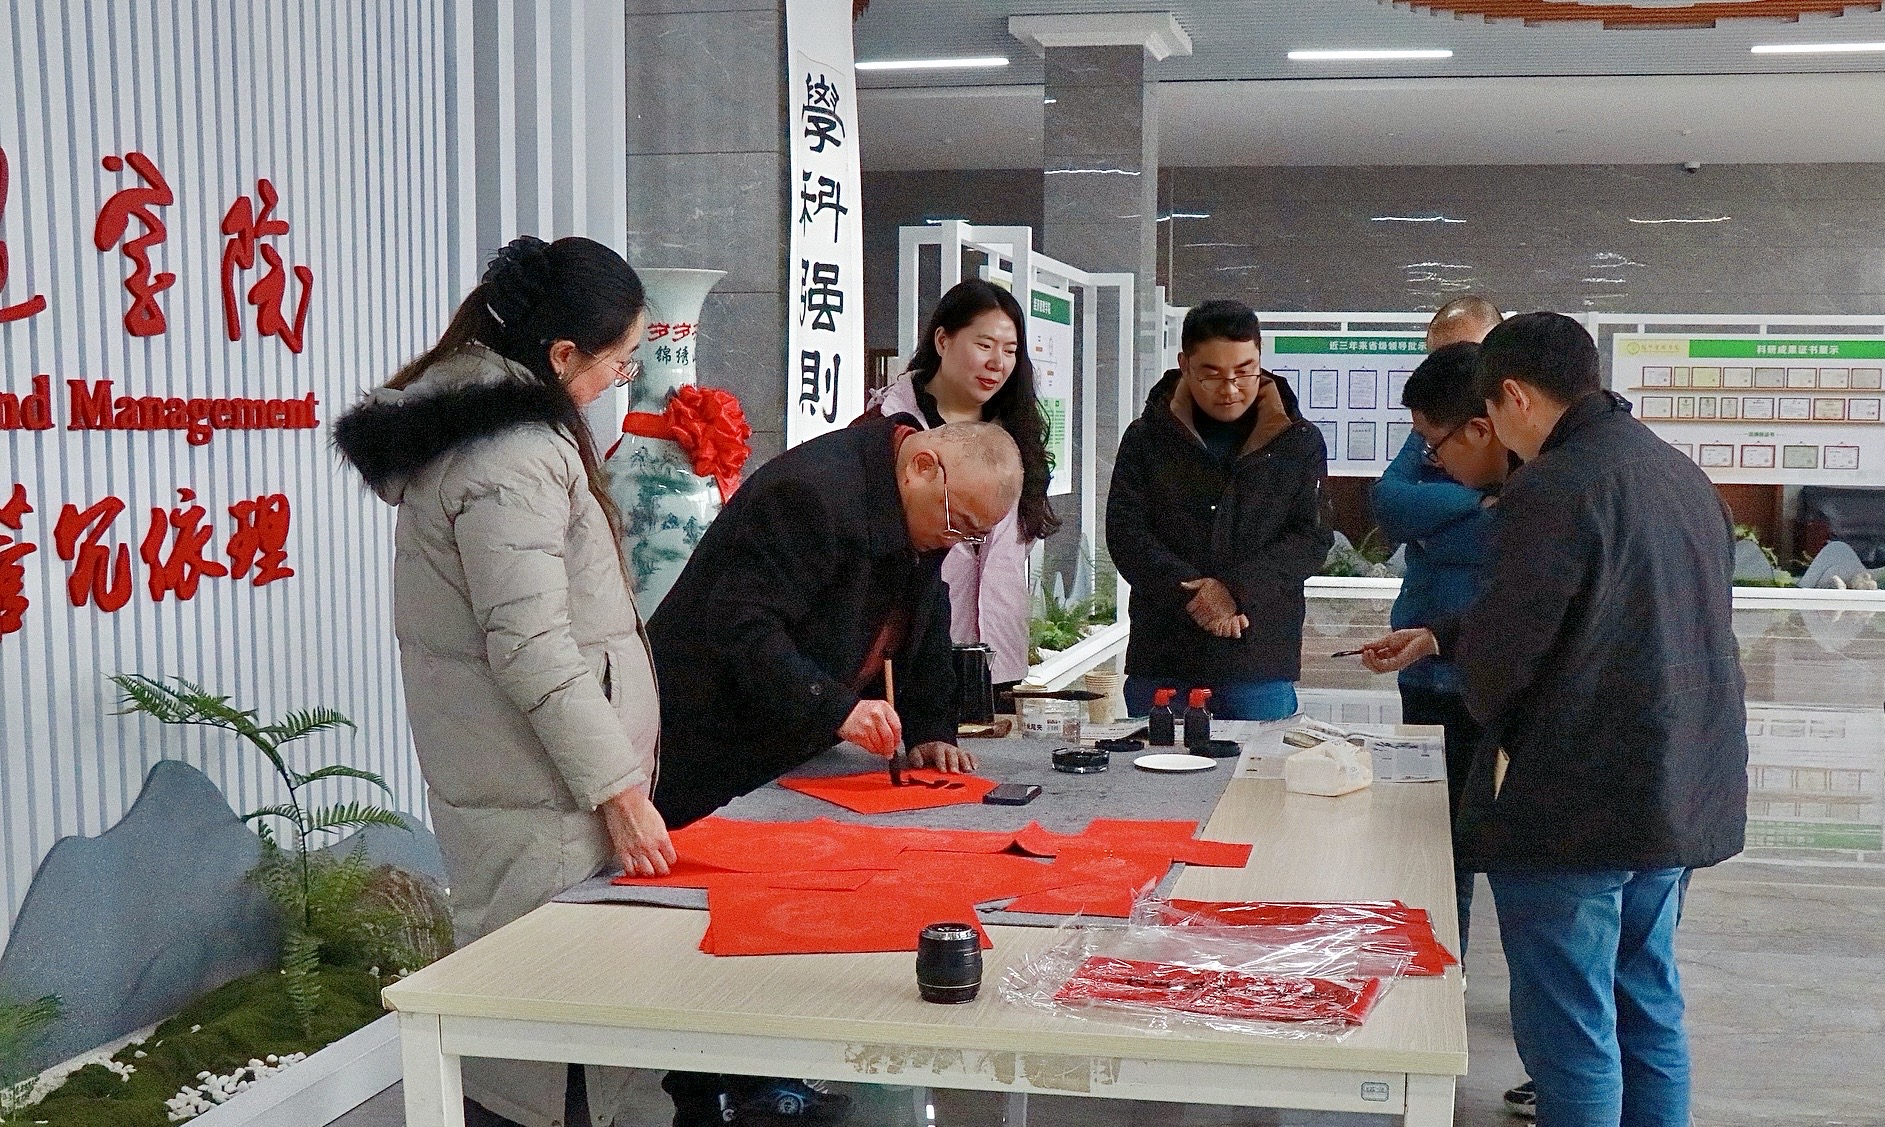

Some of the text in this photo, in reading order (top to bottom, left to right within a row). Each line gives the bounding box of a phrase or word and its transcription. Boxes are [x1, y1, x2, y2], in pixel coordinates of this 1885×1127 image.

[1757, 345, 1839, 354] 科研成果证书展示
[66, 379, 320, 446] Management
